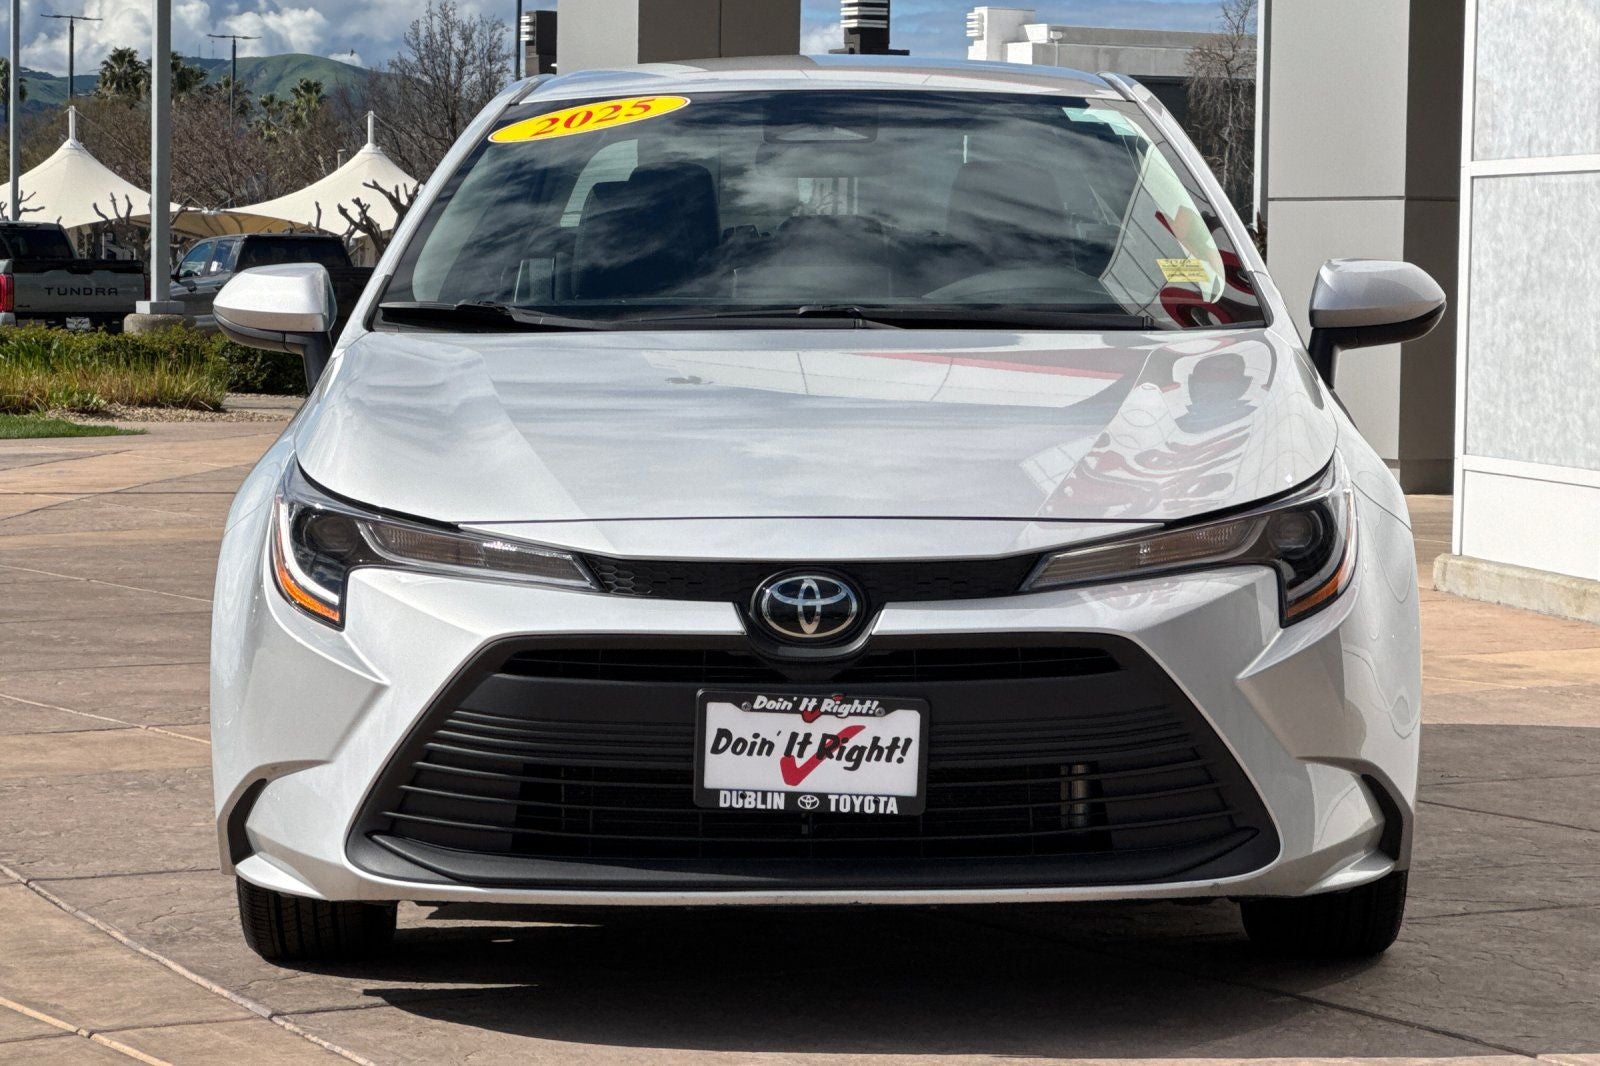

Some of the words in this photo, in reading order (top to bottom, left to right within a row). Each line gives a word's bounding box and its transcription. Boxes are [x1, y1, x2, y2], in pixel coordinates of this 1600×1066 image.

[530, 99, 656, 137] 2025
[44, 287, 118, 296] TUNDRA
[752, 695, 798, 711] Doin'
[799, 698, 818, 712] It
[820, 698, 879, 717] Right!
[709, 728, 781, 757] Doin'
[784, 731, 812, 758] It
[816, 733, 913, 771] Right!
[719, 790, 785, 810] DUBLIN
[828, 794, 899, 814] TOYOTA
